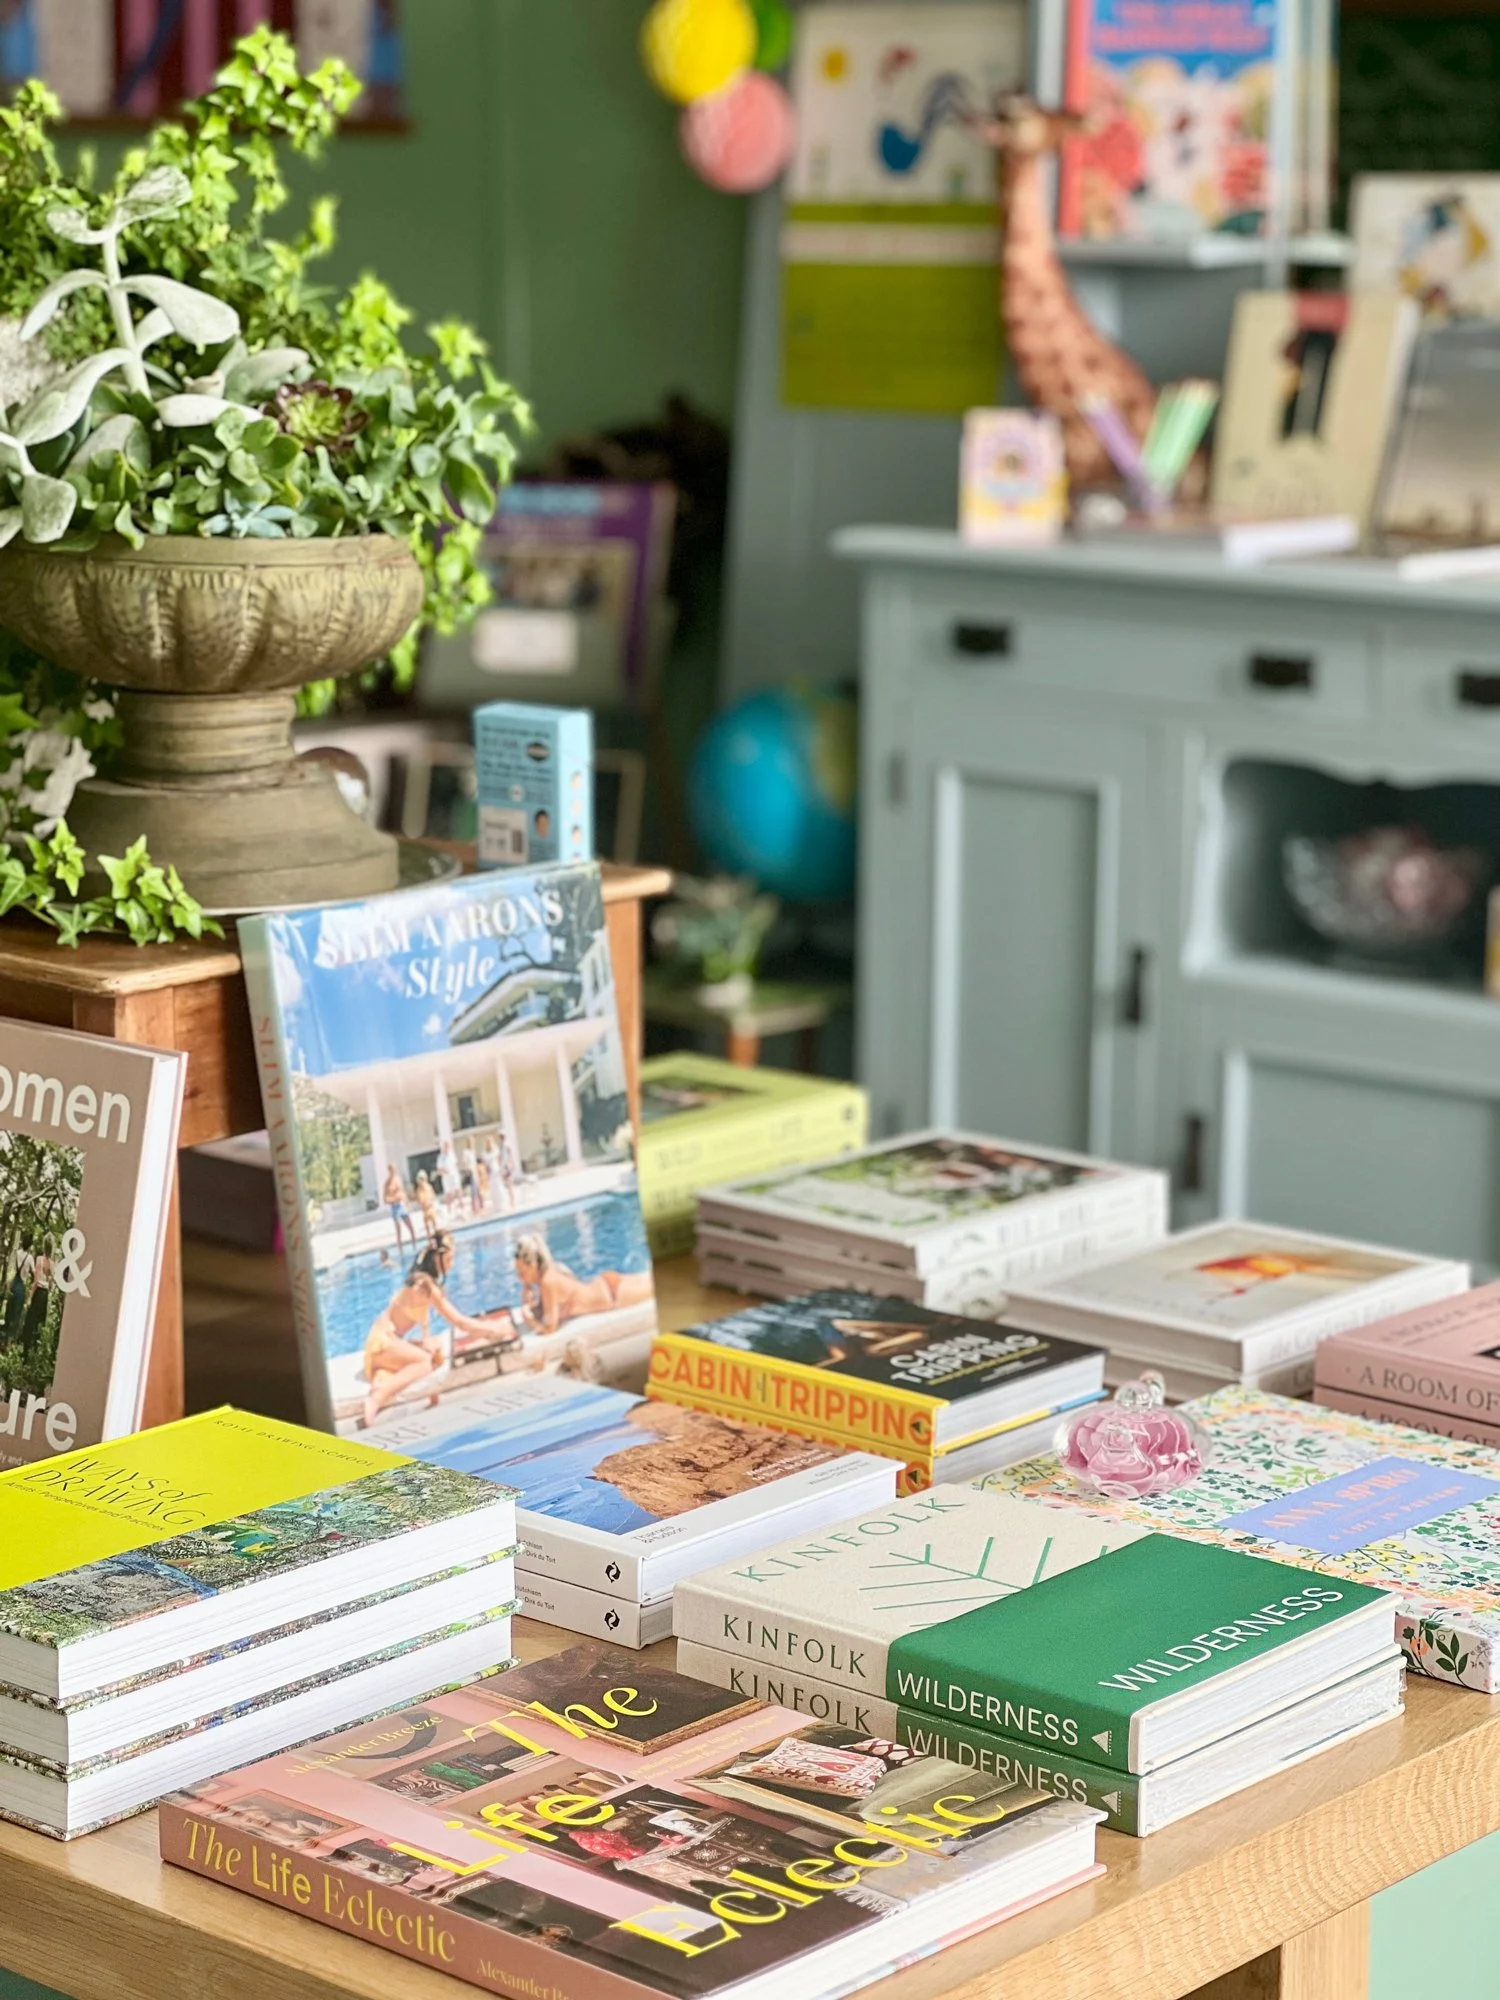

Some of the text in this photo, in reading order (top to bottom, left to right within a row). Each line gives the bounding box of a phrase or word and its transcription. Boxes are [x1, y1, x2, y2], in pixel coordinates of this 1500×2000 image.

[421, 889, 565, 949] AARONS
[405, 945, 496, 1005] Style
[55, 1228, 92, 1298] &
[649, 1346, 752, 1401] CABIN
[771, 1376, 933, 1447] TRIPPING
[1359, 1365, 1500, 1412] A ROOM OF
[213, 1419, 376, 1468] ROYAL DRAWING SCHOOL
[23, 1469, 206, 1526] DRAWING
[67, 1457, 214, 1503] WAYS of
[730, 1495, 968, 1586] KINFOLK
[1098, 1586, 1347, 1696] WILDERNESS
[722, 1613, 1081, 1747] KINFOLK WILDERNESS
[730, 1667, 872, 1735] KINFOLK
[285, 1714, 444, 1778] Alexander Breeze
[461, 1686, 658, 1757] The
[387, 1794, 615, 1876] Life
[182, 1817, 550, 2000] The Life Eclectic Alexander
[608, 1794, 1006, 1959] Eclectic
